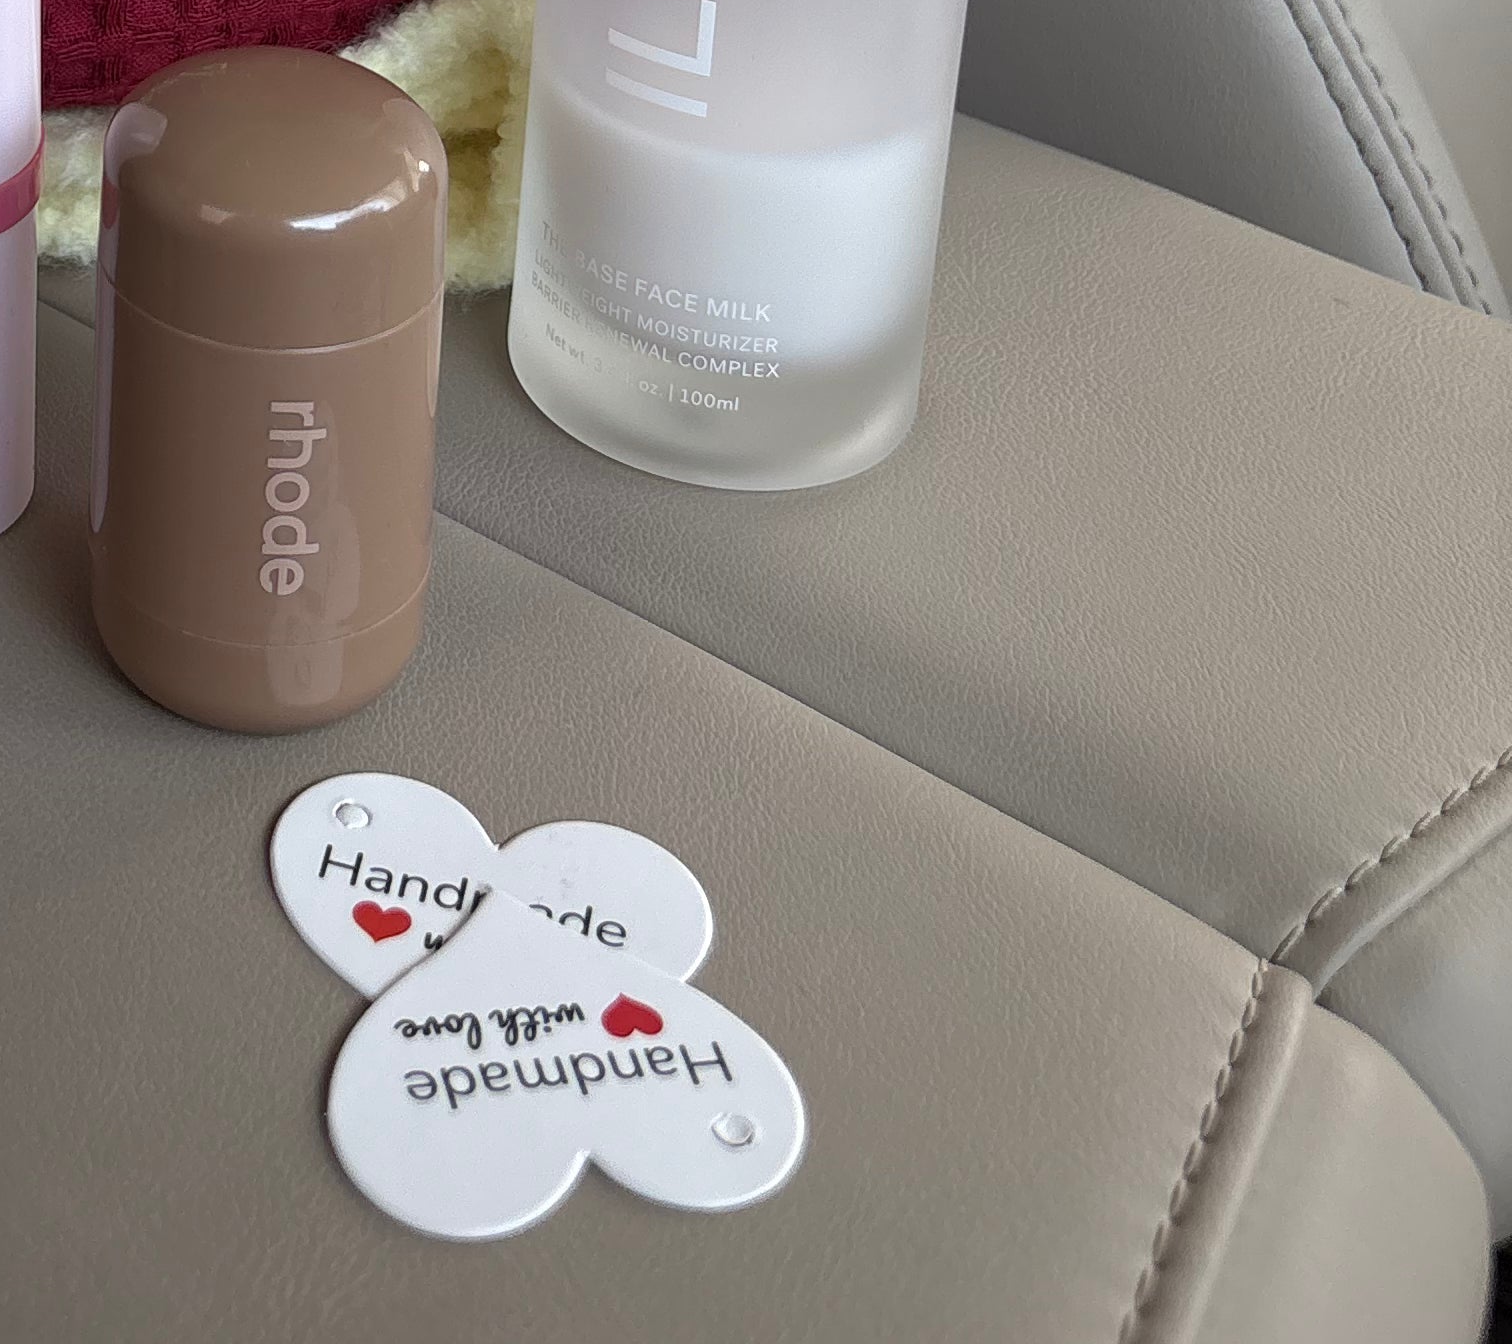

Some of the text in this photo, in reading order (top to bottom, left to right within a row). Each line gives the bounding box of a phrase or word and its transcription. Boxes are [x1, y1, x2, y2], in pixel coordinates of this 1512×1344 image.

[575, 249, 628, 293] BASE
[634, 277, 699, 313] FACE
[706, 297, 772, 323] MILK
[531, 270, 582, 325] BARRIER
[678, 351, 780, 379] COMPLEX
[637, 314, 779, 354] MOISTURIZER
[545, 323, 567, 352] Net
[680, 388, 740, 412] 100ml
[259, 401, 328, 596] rhode
[394, 1001, 586, 1051] with love
[403, 1041, 733, 1110] Handmade
